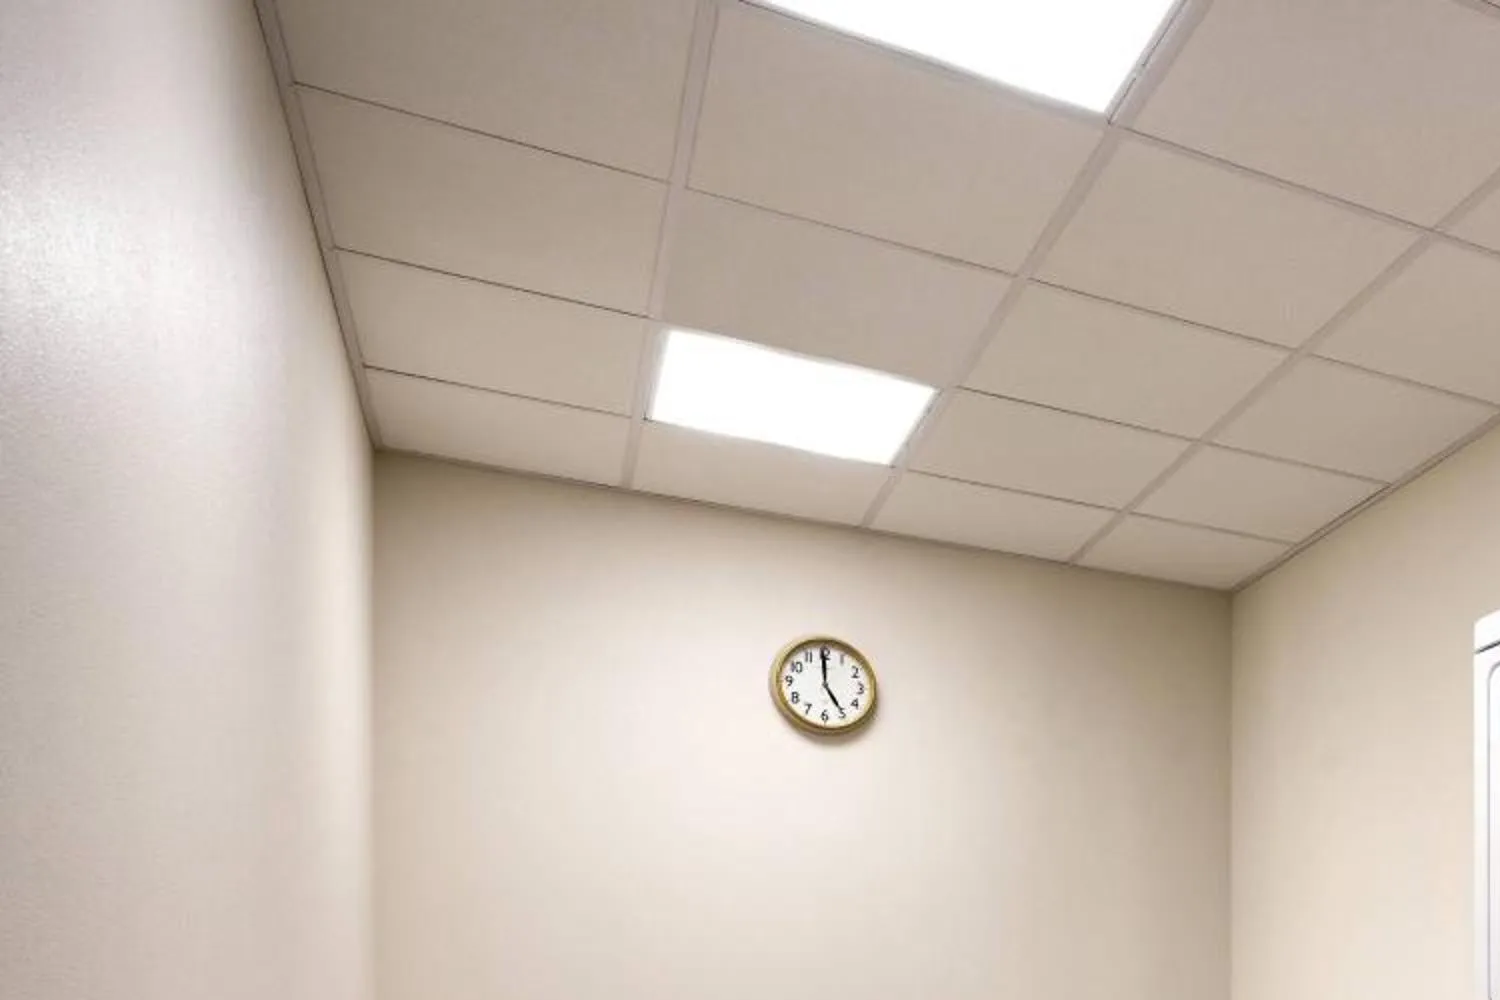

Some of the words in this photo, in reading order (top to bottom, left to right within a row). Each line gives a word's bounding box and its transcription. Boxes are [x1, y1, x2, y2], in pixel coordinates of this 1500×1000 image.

[805, 651, 813, 663] 11
[840, 653, 845, 665] 1
[791, 661, 803, 673] 10
[851, 666, 860, 679] 2
[785, 675, 794, 687] 9
[857, 682, 865, 695] 3
[791, 692, 800, 704] 8
[851, 698, 859, 709] 4
[804, 703, 812, 714] 7
[839, 708, 846, 719] 5
[821, 709, 829, 722] 6
